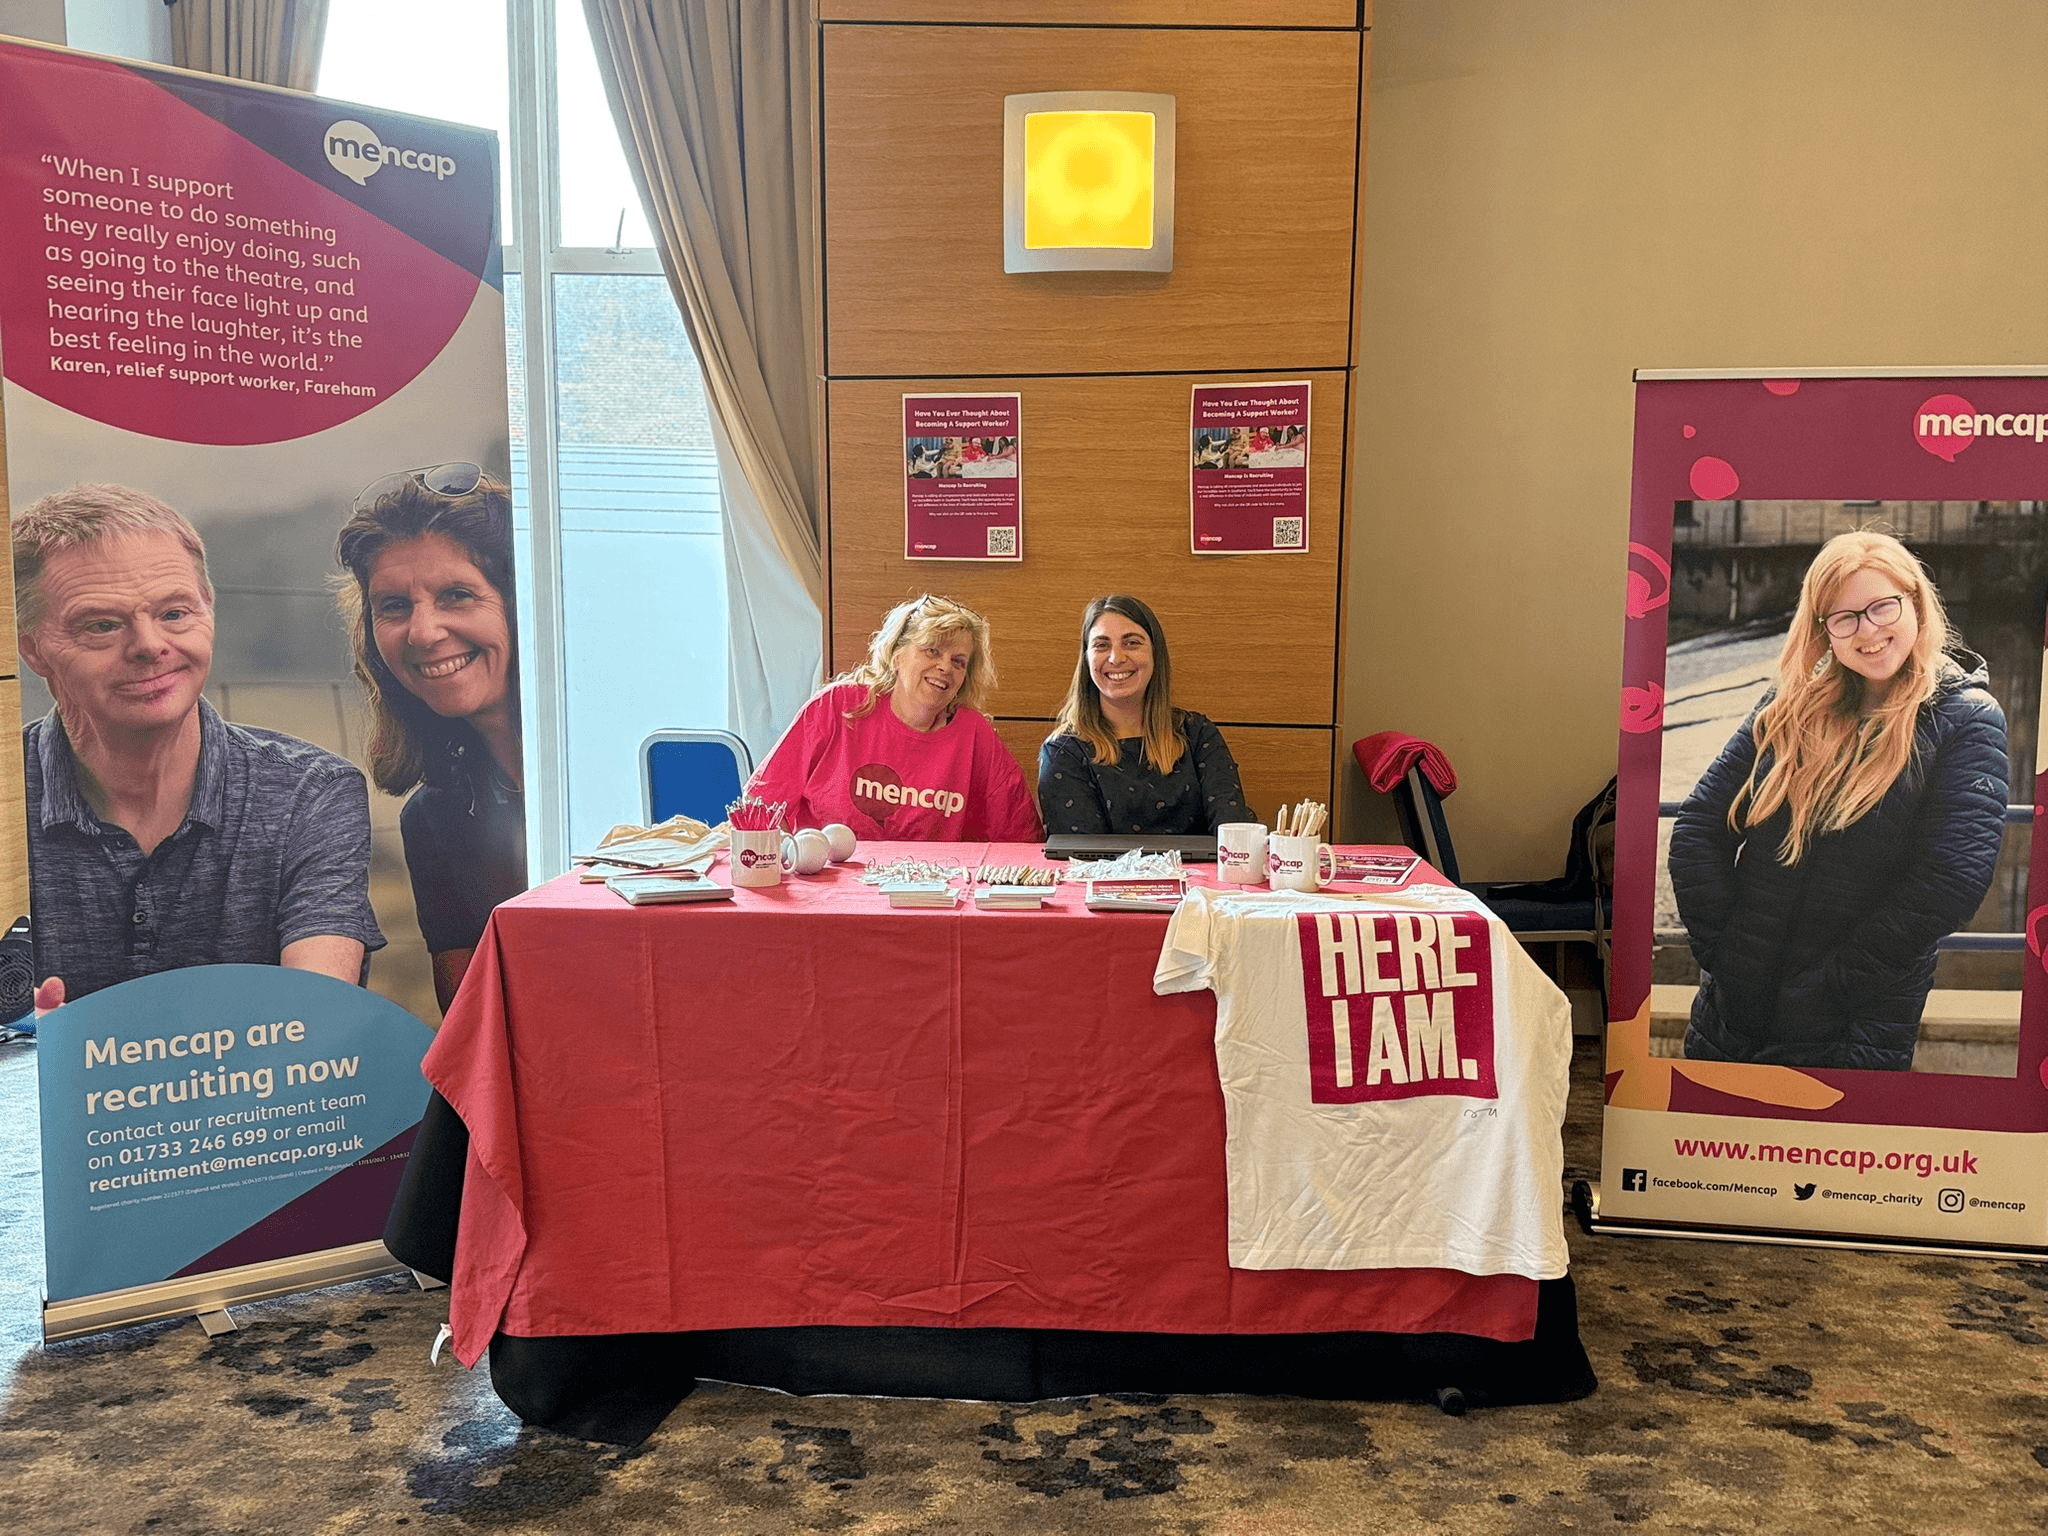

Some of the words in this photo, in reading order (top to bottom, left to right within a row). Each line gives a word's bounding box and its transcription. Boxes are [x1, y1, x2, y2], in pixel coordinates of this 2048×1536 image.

[329, 135, 456, 180] mencap
[132, 168, 140, 186] I
[148, 175, 234, 199] support
[44, 188, 152, 215] someone
[160, 201, 183, 218] to
[191, 204, 217, 224] do
[226, 214, 336, 246] something
[44, 213, 97, 240] they
[106, 224, 168, 251] really
[177, 232, 235, 258] enjoy
[243, 239, 305, 268] doing,
[313, 252, 360, 270] such
[46, 246, 72, 261] as
[81, 248, 145, 274] going
[153, 255, 176, 273] to
[183, 258, 218, 278] the
[226, 261, 308, 296] theatre,
[316, 278, 354, 296] and
[47, 274, 124, 300] seeing
[132, 280, 185, 301] their
[192, 286, 237, 308] face
[245, 292, 290, 317] light
[297, 304, 322, 323] up
[330, 306, 368, 322] and
[49, 298, 138, 330] hearing
[146, 308, 184, 328] the
[192, 312, 285, 345] laughter,
[328, 330, 362, 348] the
[50, 327, 101, 349] best
[108, 332, 185, 361] feeling
[194, 340, 212, 359] in
[219, 344, 253, 364] the
[51, 356, 110, 376] Karen,
[117, 362, 164, 378] relief
[170, 369, 234, 385] support
[239, 376, 299, 394] worker,
[305, 380, 376, 396] Fareham
[1919, 413, 2048, 443] mencap
[856, 776, 964, 817] mencap
[741, 853, 777, 861] mencap
[1315, 912, 1478, 997] HERE
[85, 1028, 235, 1070] Mencap
[247, 1021, 304, 1046] are
[1332, 999, 1353, 1087] I
[1366, 991, 1478, 1085] AM.
[86, 1066, 274, 1114] recruiting
[286, 1056, 358, 1085] now
[88, 1122, 164, 1146] Contact
[170, 1118, 201, 1139] our
[208, 1100, 315, 1128] recruitment
[321, 1094, 365, 1110] team
[89, 1156, 112, 1169] on
[120, 1142, 182, 1164] 01733
[190, 1135, 225, 1153] 246
[232, 1128, 266, 1146] 699
[274, 1128, 291, 1140] or
[297, 1115, 345, 1136] email
[89, 1135, 363, 1193] recruitment@mencap.org.uk
[1674, 1139, 1977, 1178] www.mencap.org.uk
[1653, 1177, 1777, 1196] facebook.com/Mencap
[1822, 1190, 1922, 1206] @mencap_charity
[1970, 1198, 2025, 1212] @mencap
